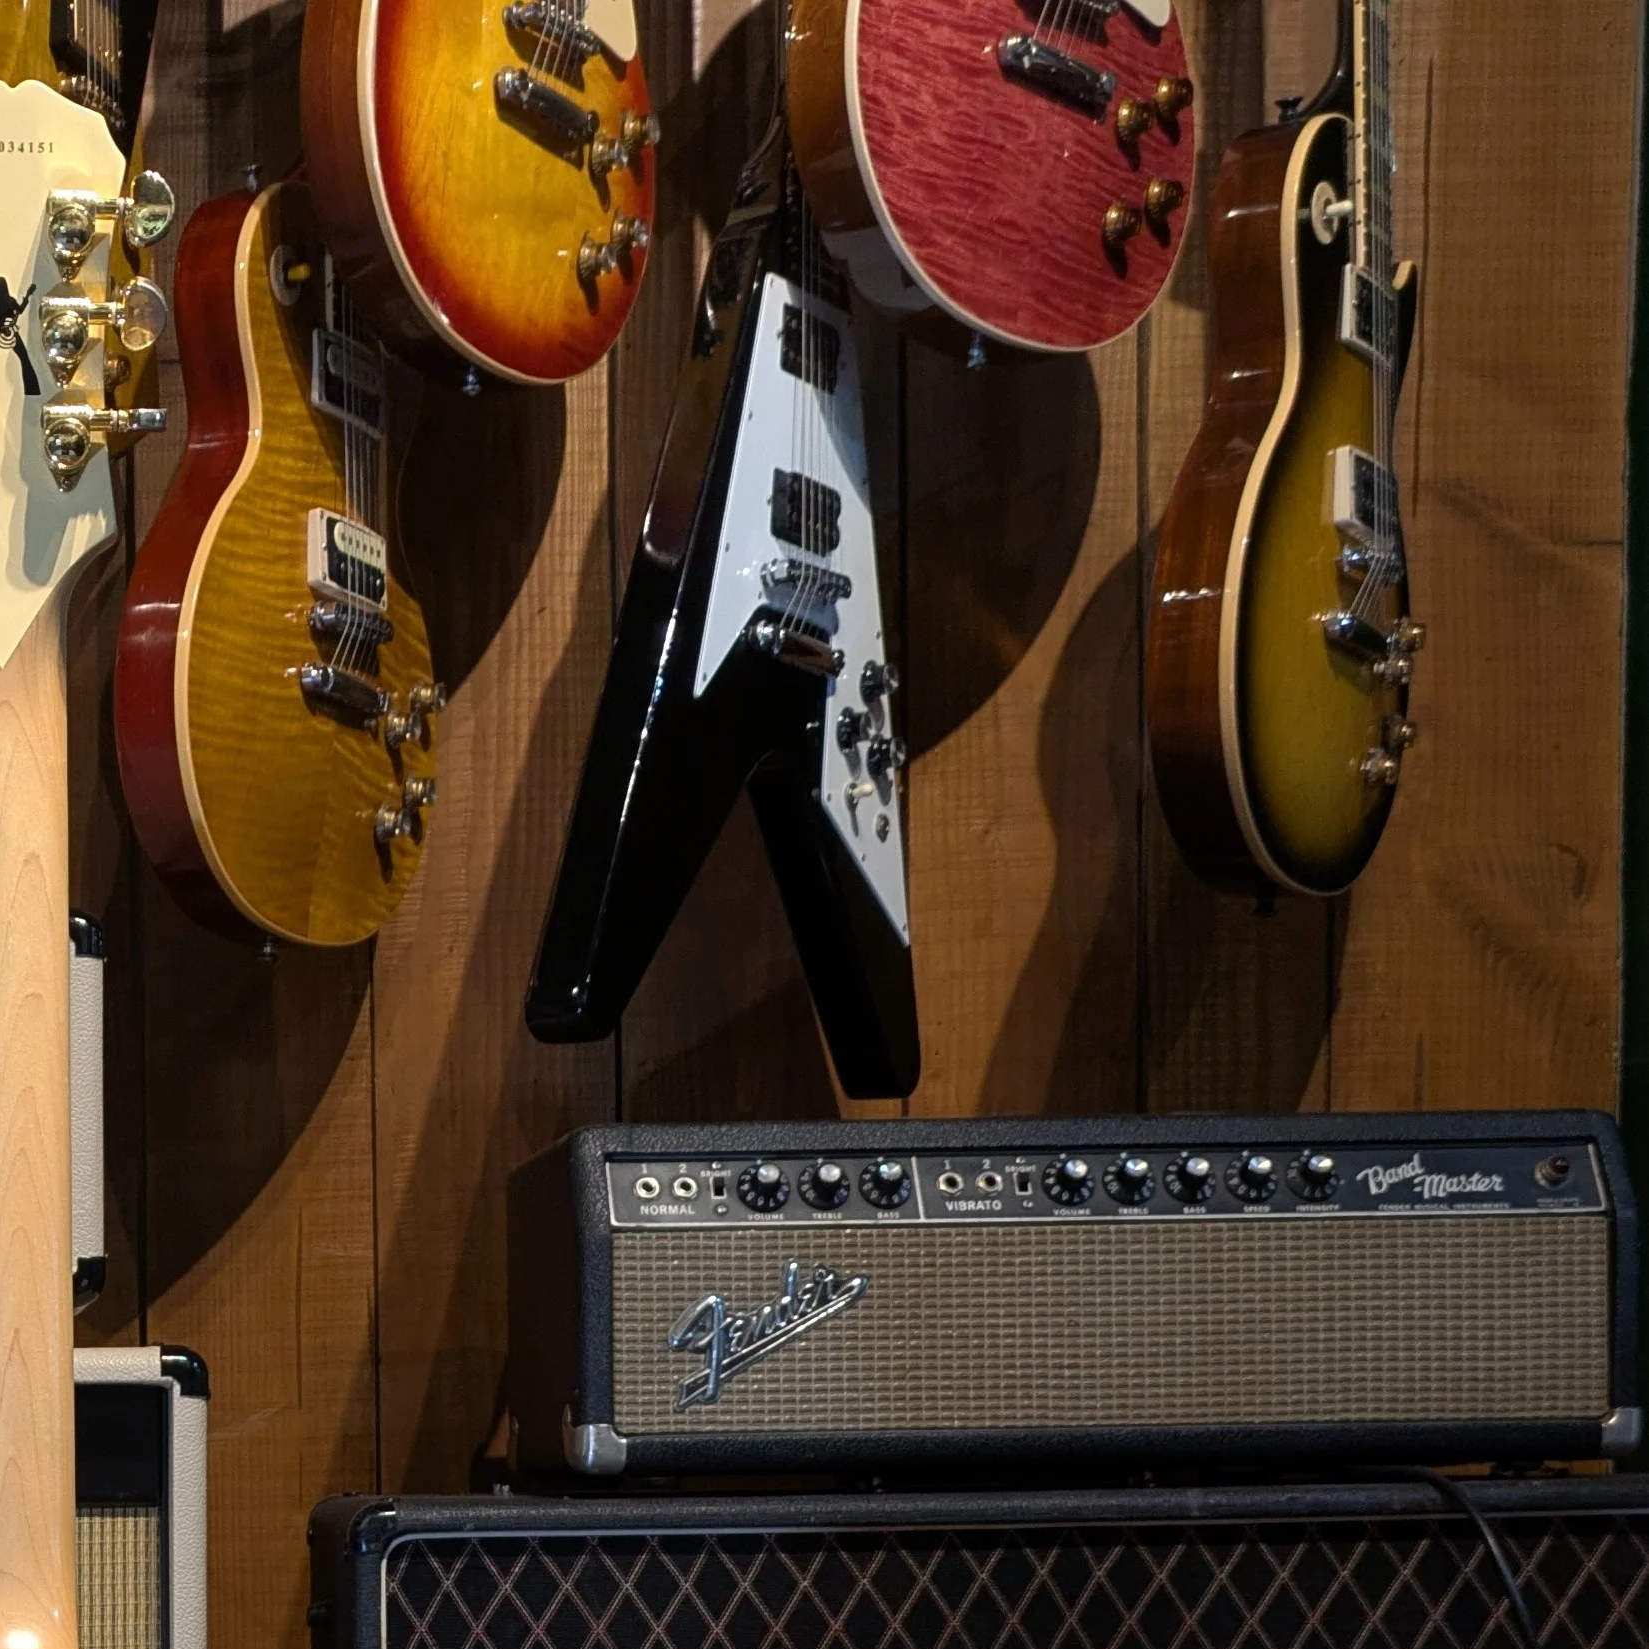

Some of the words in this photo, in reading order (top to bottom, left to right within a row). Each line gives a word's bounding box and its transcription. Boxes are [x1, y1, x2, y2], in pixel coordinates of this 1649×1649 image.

[641, 1163, 648, 1174] 1
[678, 1163, 688, 1174] 2
[944, 1159, 951, 1169] 1
[982, 1159, 991, 1169] 2
[1356, 1151, 1426, 1196] Band
[1412, 1171, 1506, 1200] Master
[640, 1205, 696, 1216] NORMAL
[945, 1200, 1002, 1212] VIBRATO
[667, 1257, 870, 1412] Fender
